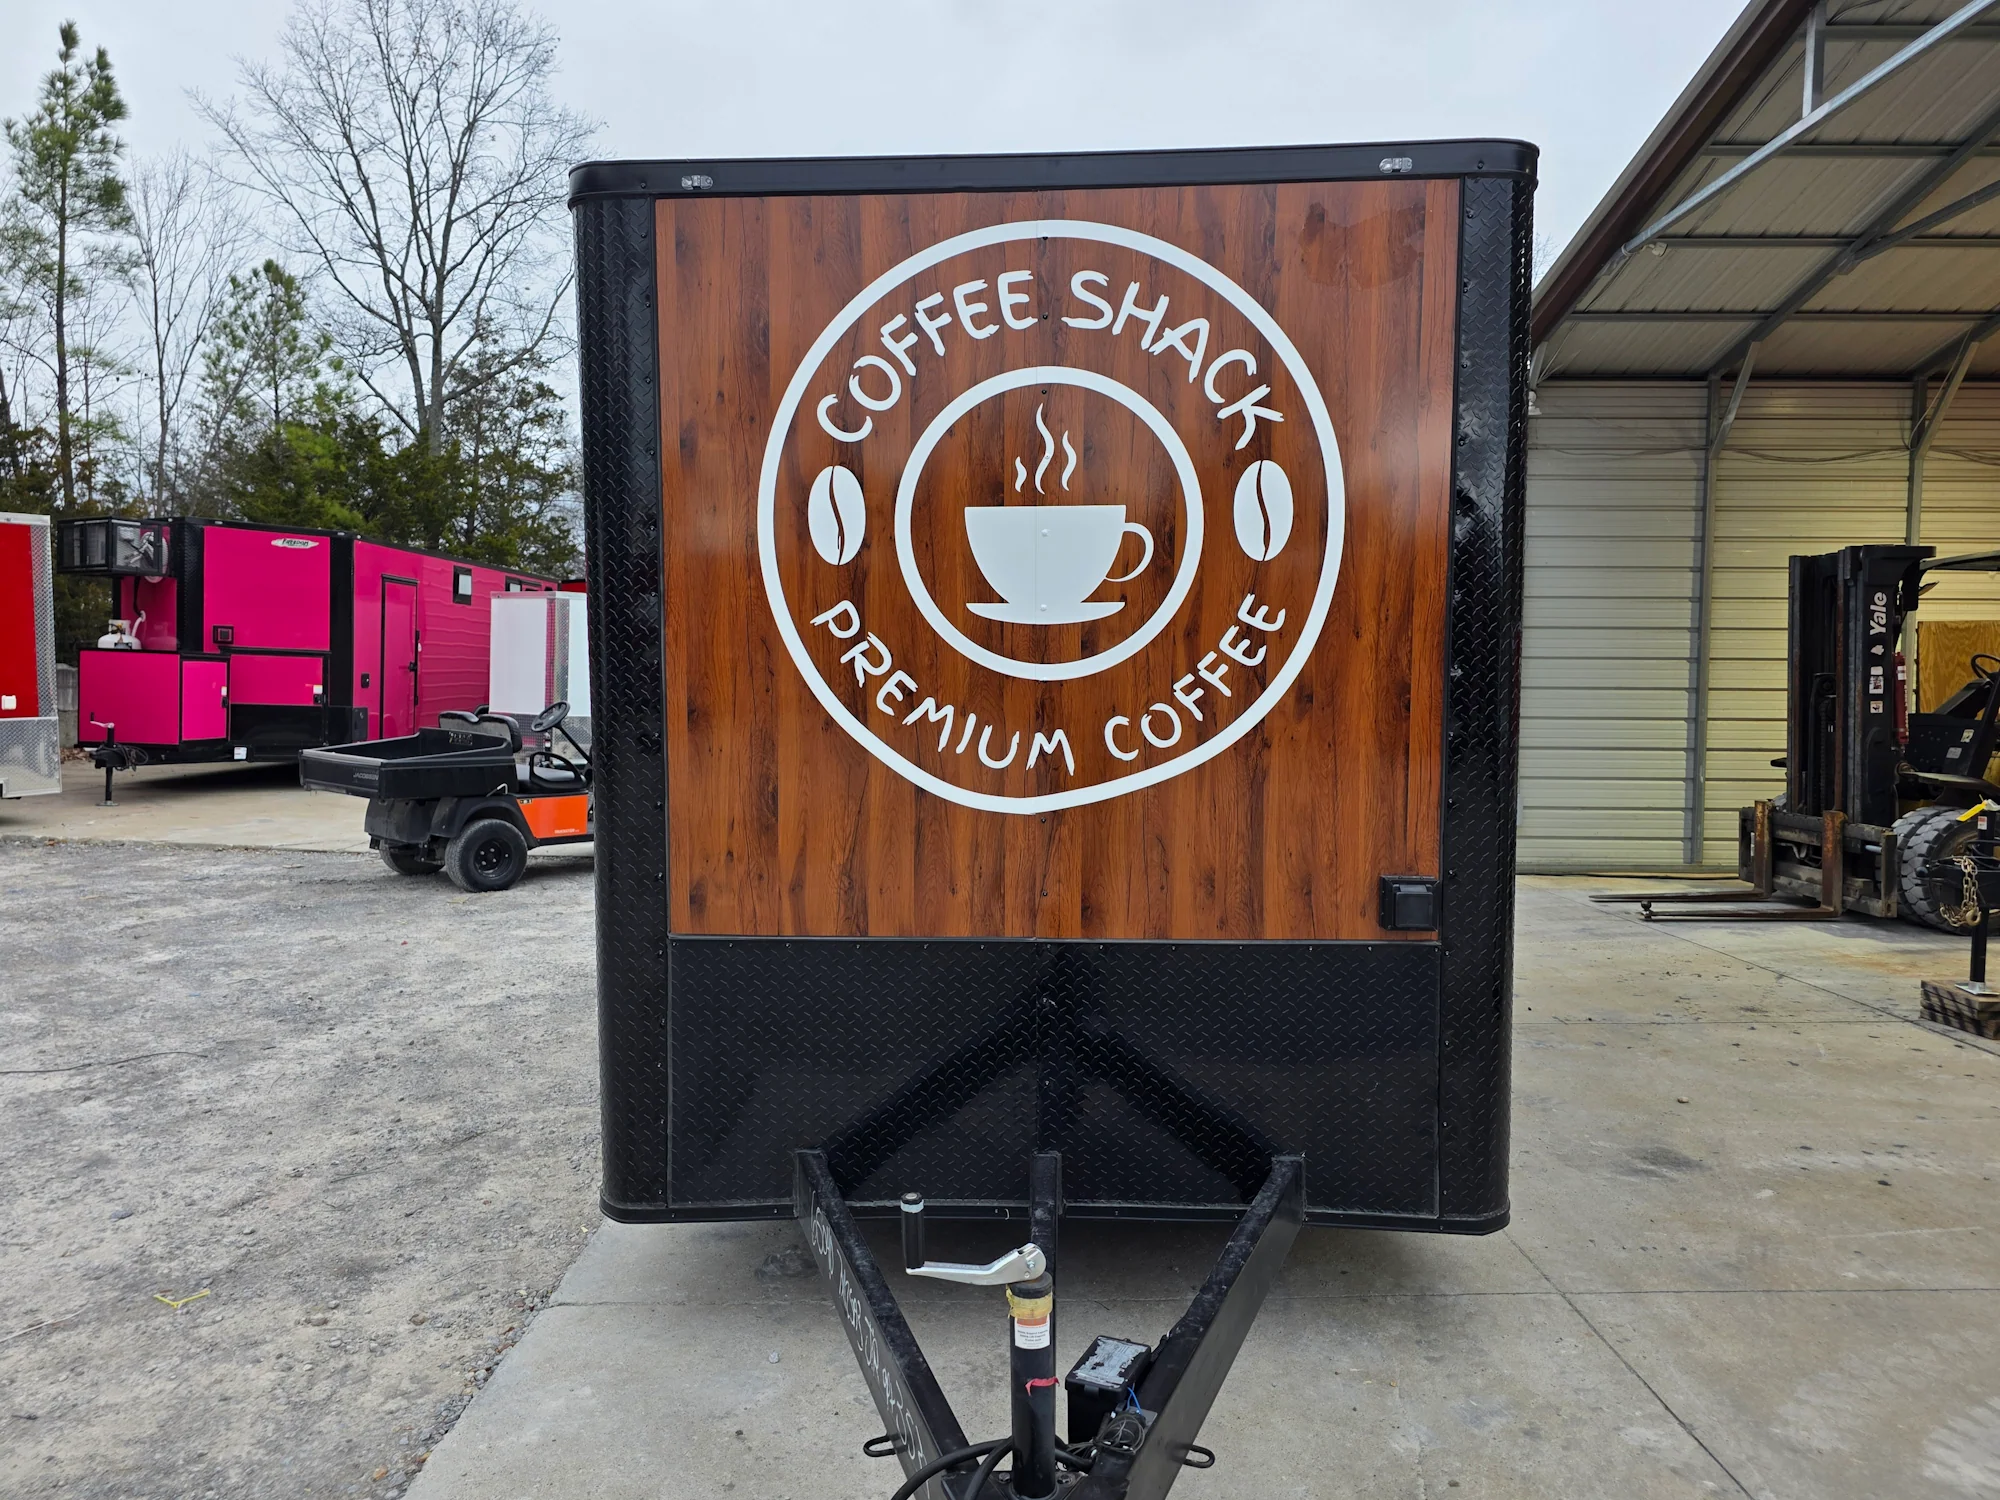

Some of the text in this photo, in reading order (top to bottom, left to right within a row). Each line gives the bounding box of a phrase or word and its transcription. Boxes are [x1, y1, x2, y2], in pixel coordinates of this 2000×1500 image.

[816, 270, 1284, 450] COFFEE SHACK
[810, 593, 1286, 775] PREMIUM COFFEE
[1869, 591, 1887, 635] Yale
